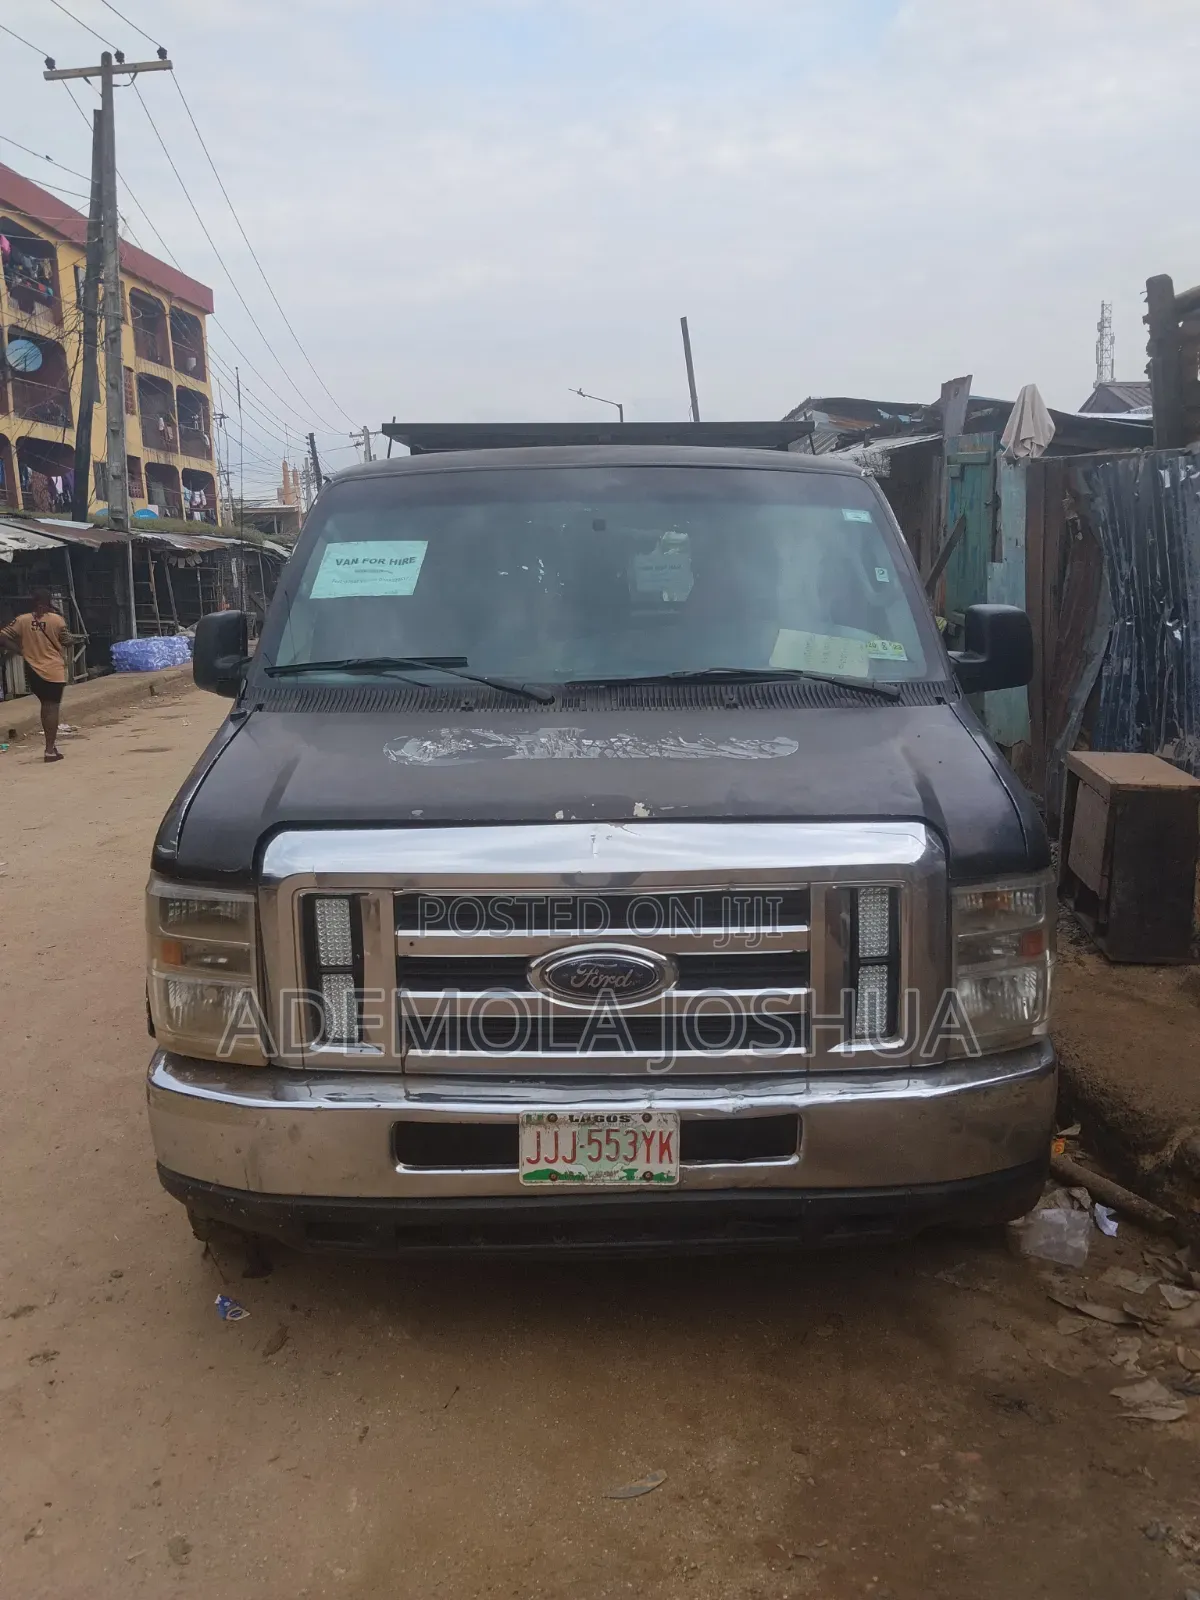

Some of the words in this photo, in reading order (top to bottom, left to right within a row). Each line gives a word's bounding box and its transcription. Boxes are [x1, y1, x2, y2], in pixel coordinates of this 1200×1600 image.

[335, 557, 359, 566] VAN
[361, 557, 386, 565] FOR
[388, 556, 417, 566] HIRE
[570, 962, 633, 988] Ford
[568, 1114, 631, 1123] LAGOS
